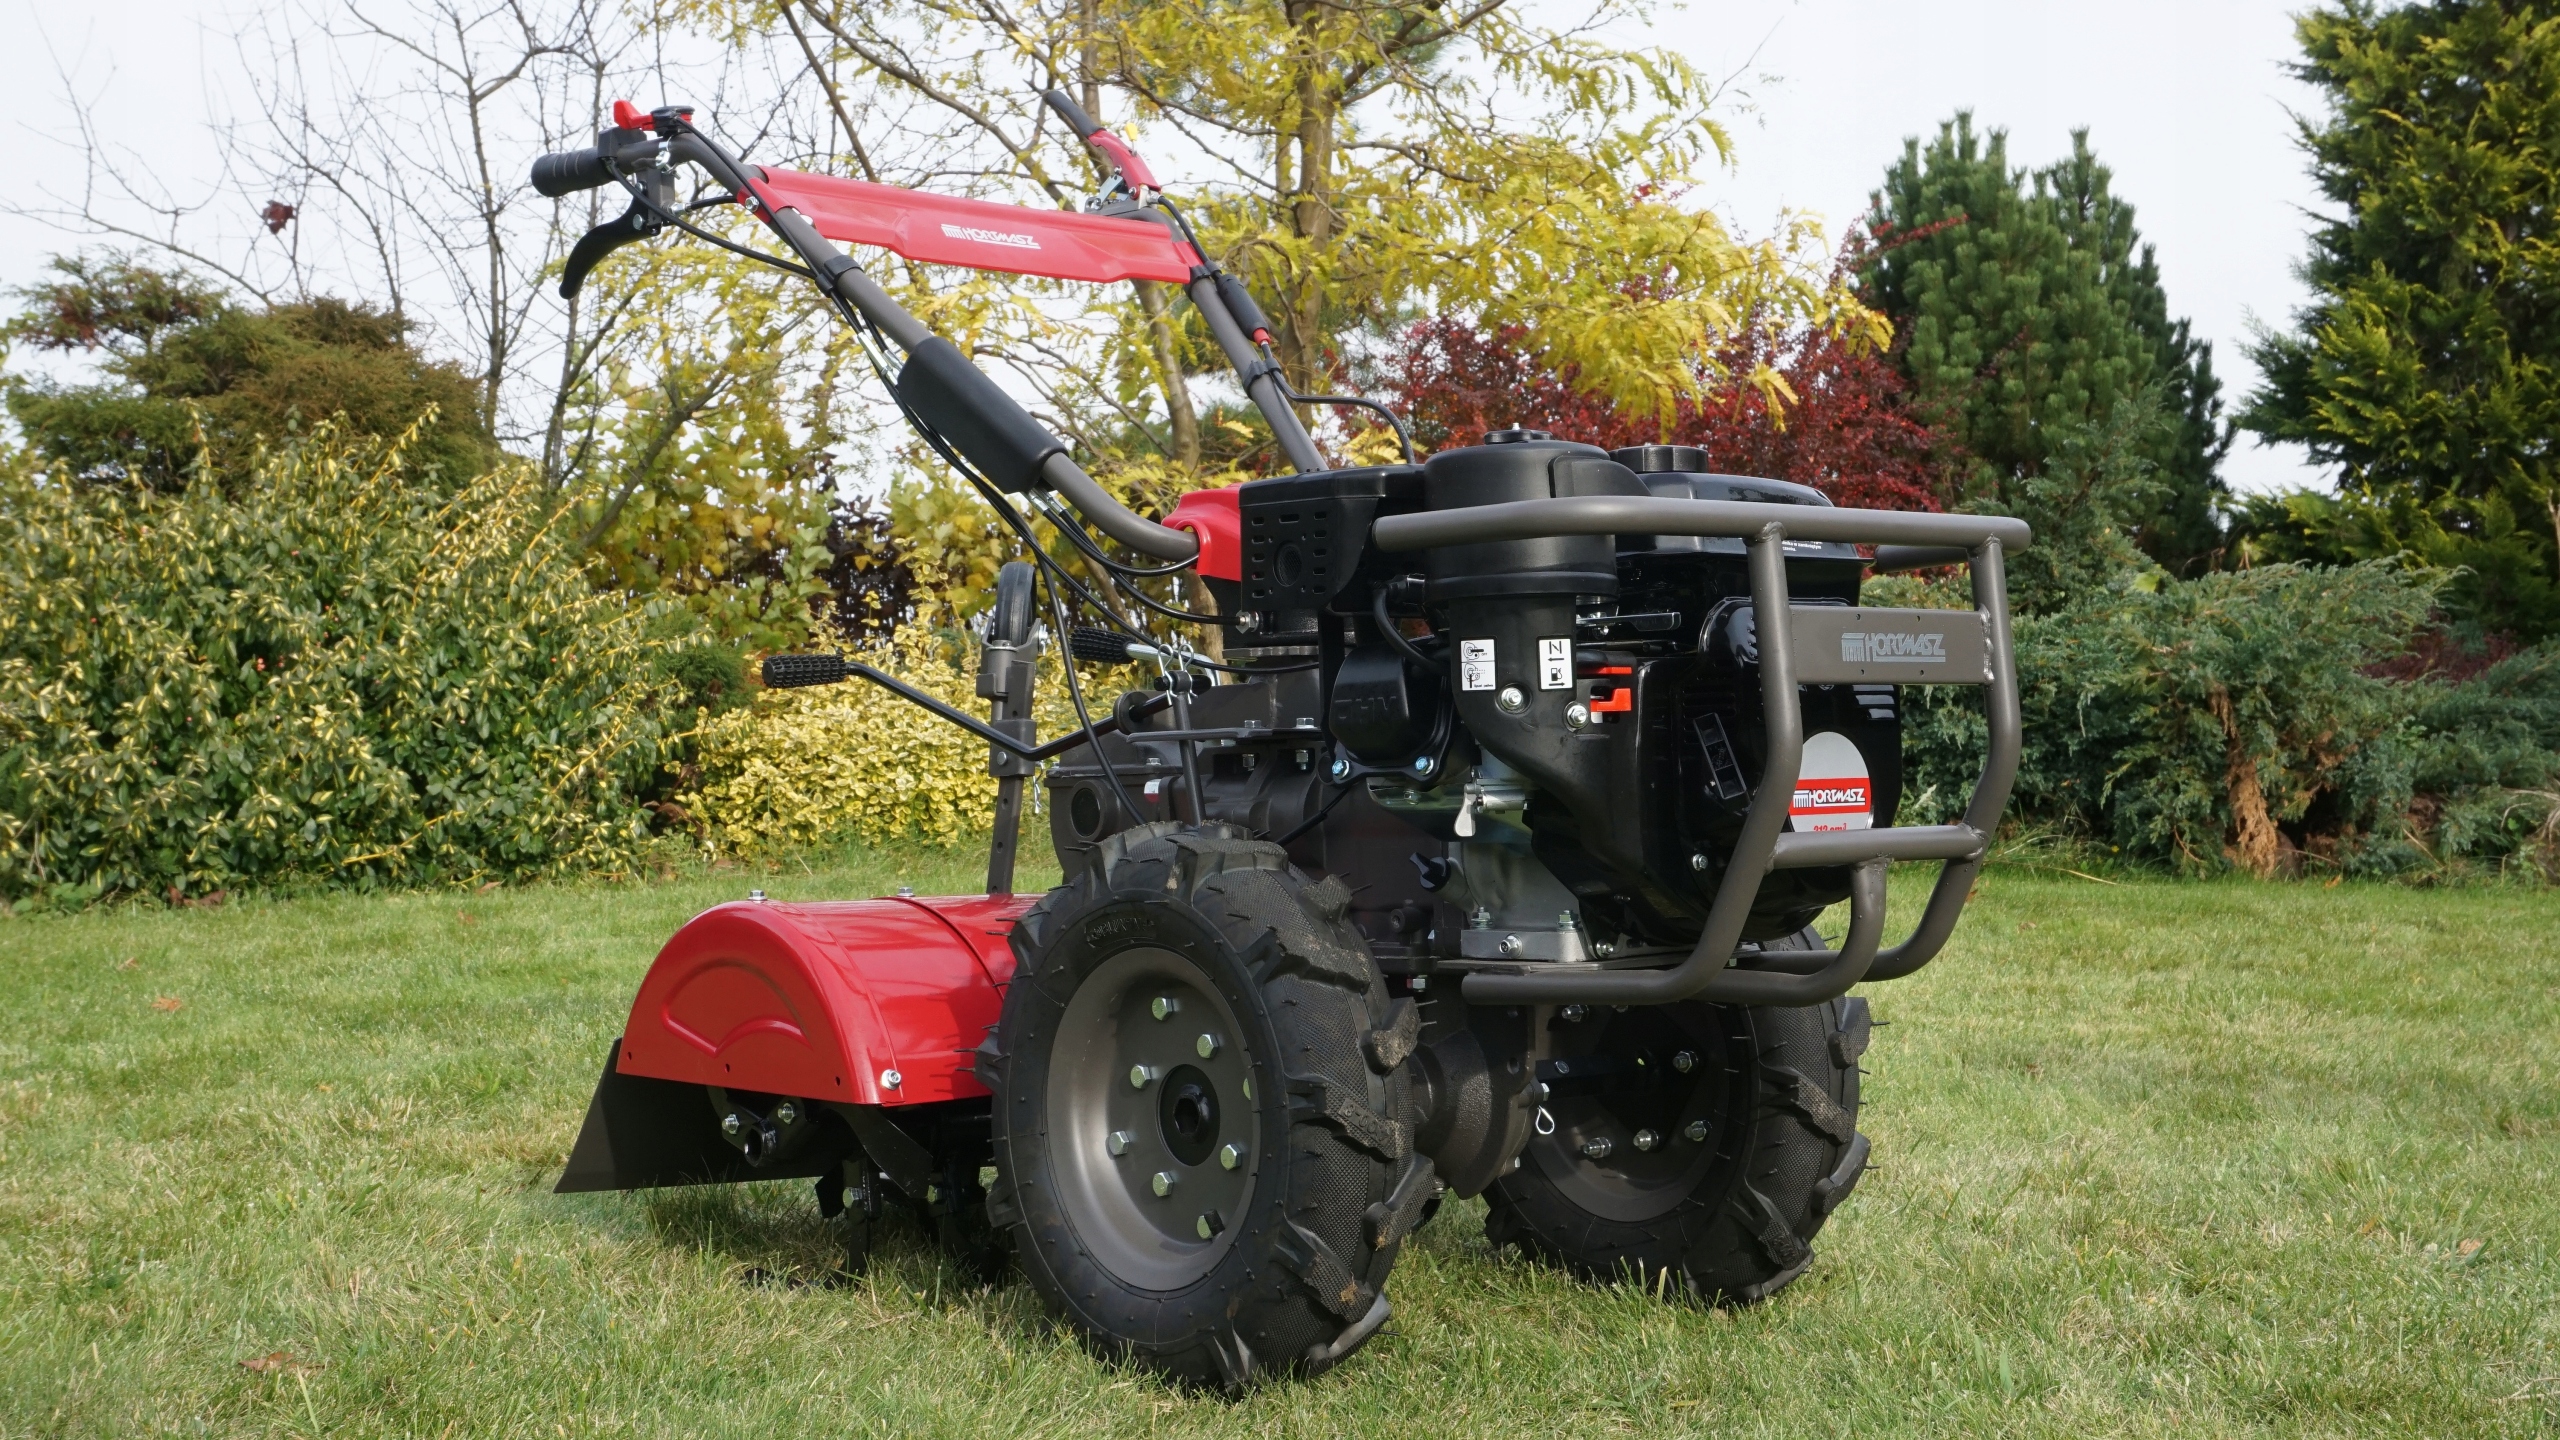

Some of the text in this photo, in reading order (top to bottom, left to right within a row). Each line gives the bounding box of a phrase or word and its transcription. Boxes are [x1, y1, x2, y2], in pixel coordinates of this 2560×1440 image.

[962, 227, 1041, 249] HORTMASZ
[1865, 633, 1946, 662] HORTMASZ
[1809, 788, 1866, 807] HORTMASZ
